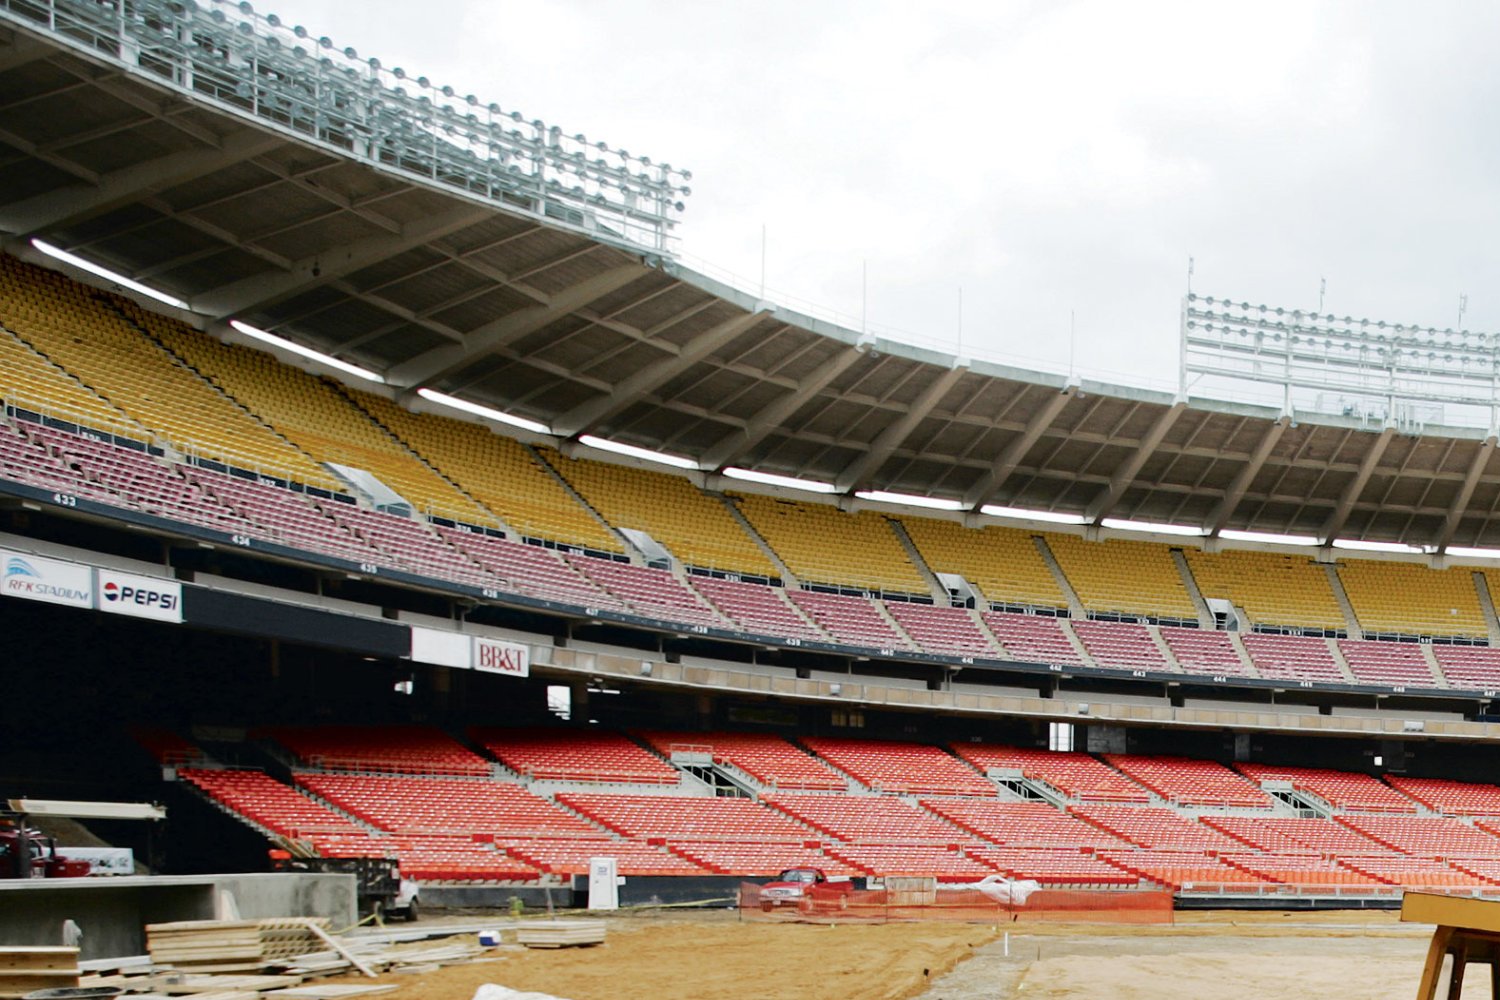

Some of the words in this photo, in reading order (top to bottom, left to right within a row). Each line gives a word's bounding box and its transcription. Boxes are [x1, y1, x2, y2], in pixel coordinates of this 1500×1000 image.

[54, 493, 76, 507] 433
[232, 535, 250, 546] 434
[8, 579, 34, 592] RFK
[35, 583, 90, 602] STADIUM
[120, 586, 178, 611] PEPSI
[479, 643, 525, 673] BB&T
